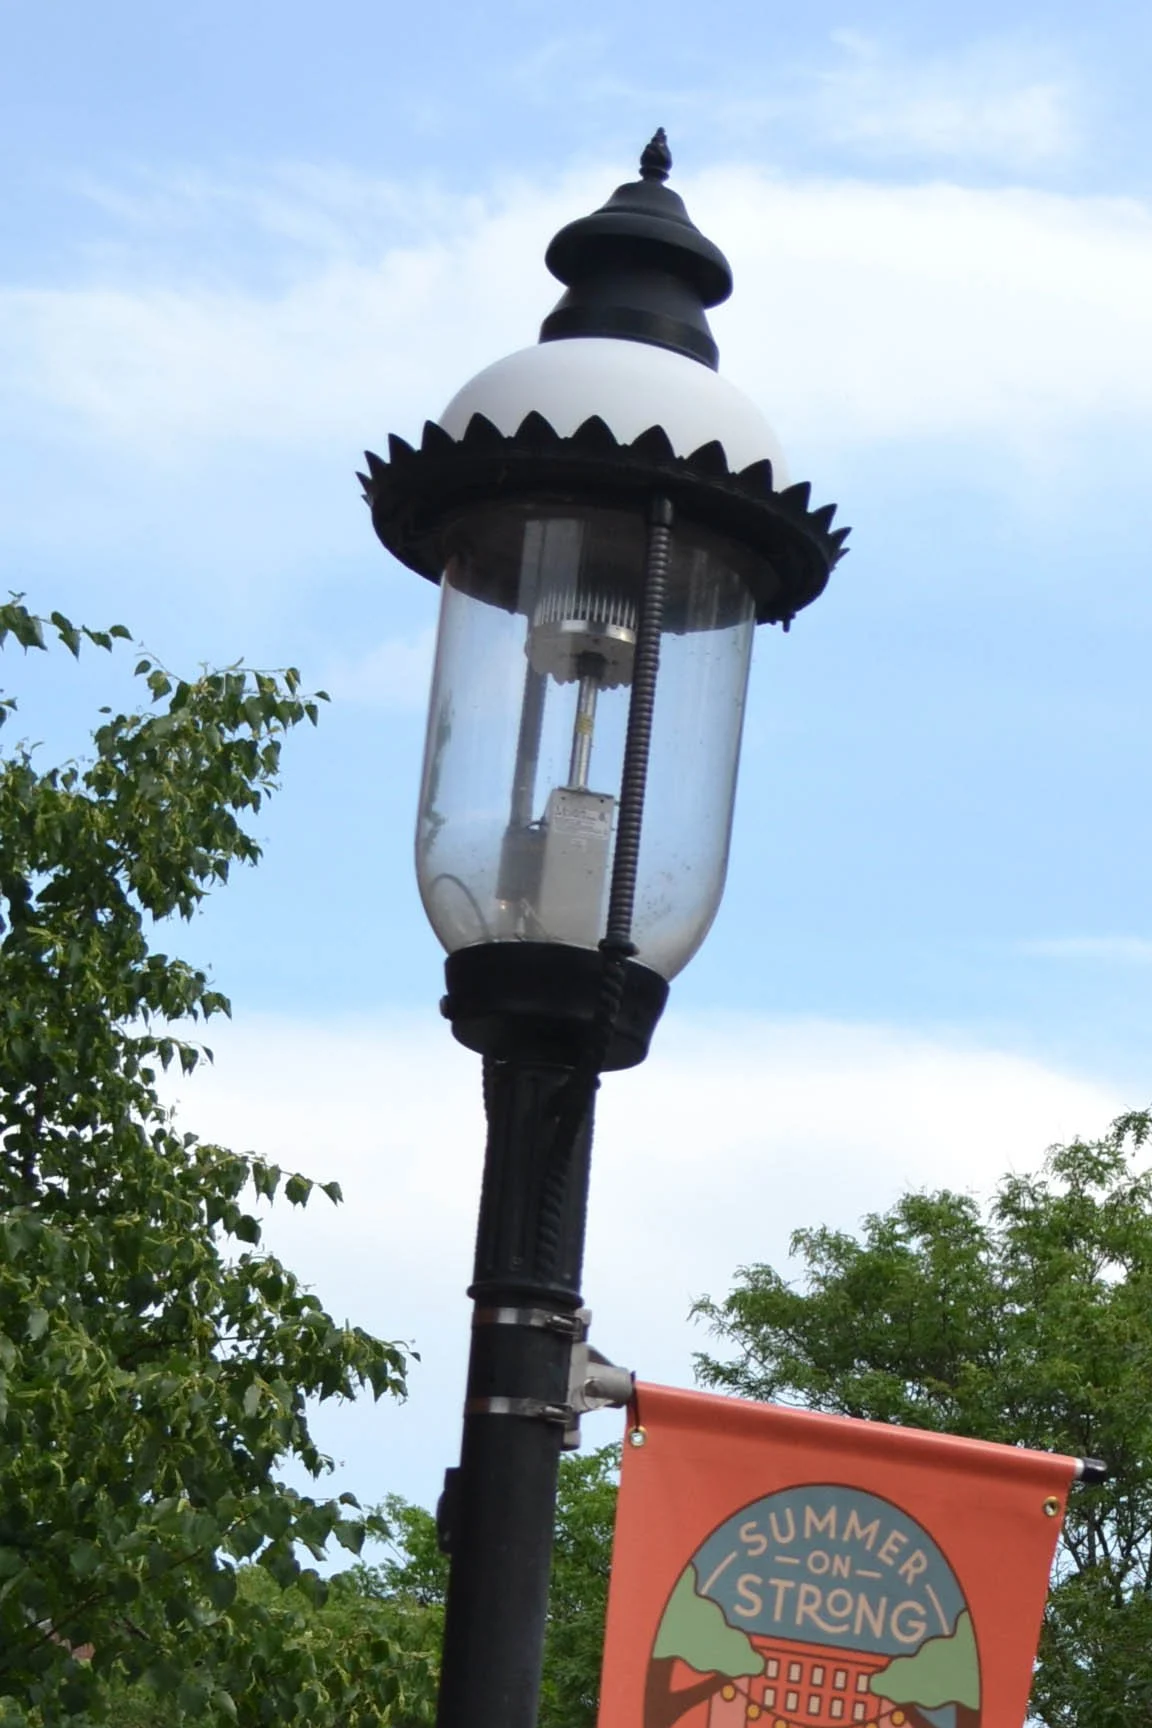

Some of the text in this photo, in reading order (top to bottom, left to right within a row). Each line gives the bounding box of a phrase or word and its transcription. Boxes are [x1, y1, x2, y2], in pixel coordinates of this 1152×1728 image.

[738, 1505, 929, 1587] SUMMER
[807, 1549, 851, 1578] ON
[733, 1573, 928, 1644] STRONG
